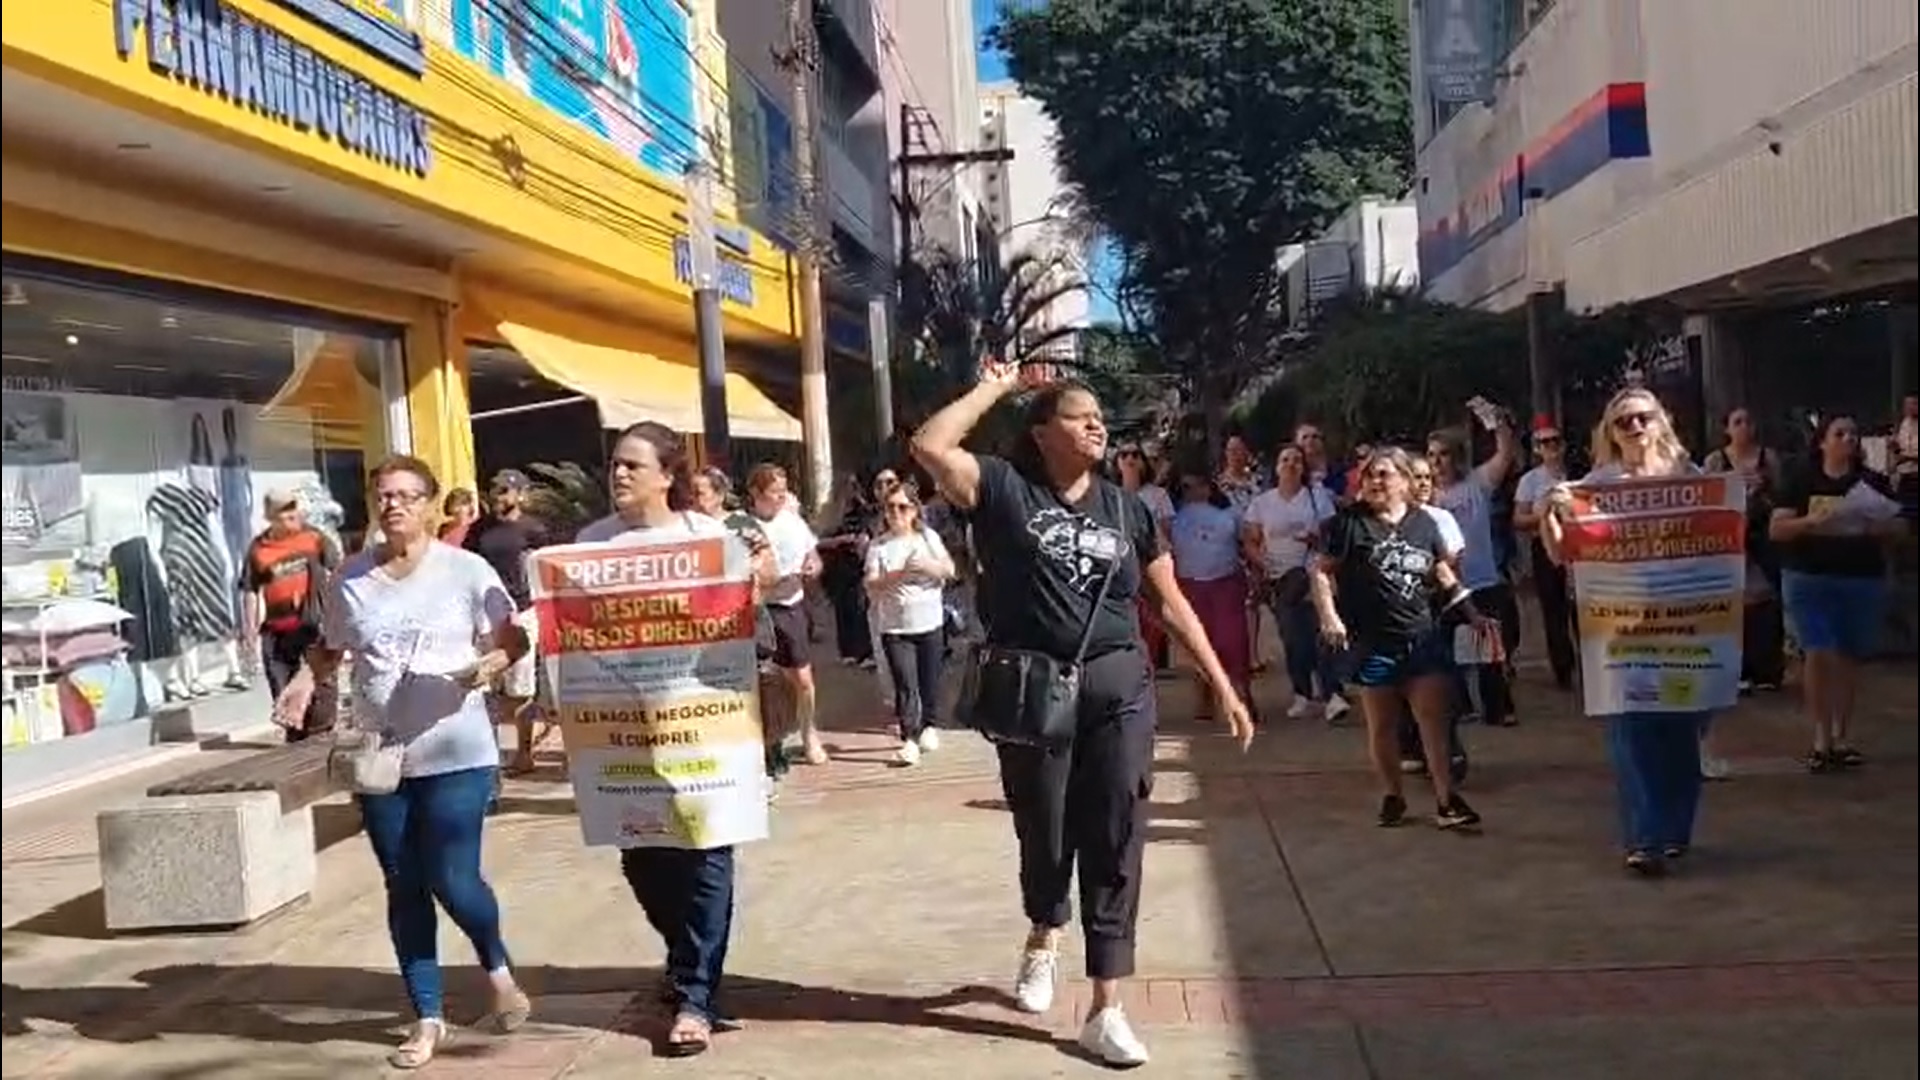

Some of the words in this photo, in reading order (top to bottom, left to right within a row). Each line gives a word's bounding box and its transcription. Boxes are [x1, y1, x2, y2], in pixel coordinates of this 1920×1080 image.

[113, 0, 430, 178] PERNAMBUCANAS
[1592, 485, 1702, 514] PREFEITO!
[564, 551, 700, 586] PREFEITO!
[592, 592, 691, 621] RESPEITE
[556, 622, 635, 649] NOSSOS
[640, 613, 739, 643] DIREITOS!
[655, 699, 745, 722] NEGOCIA!
[624, 729, 701, 748] CUMPRE!
